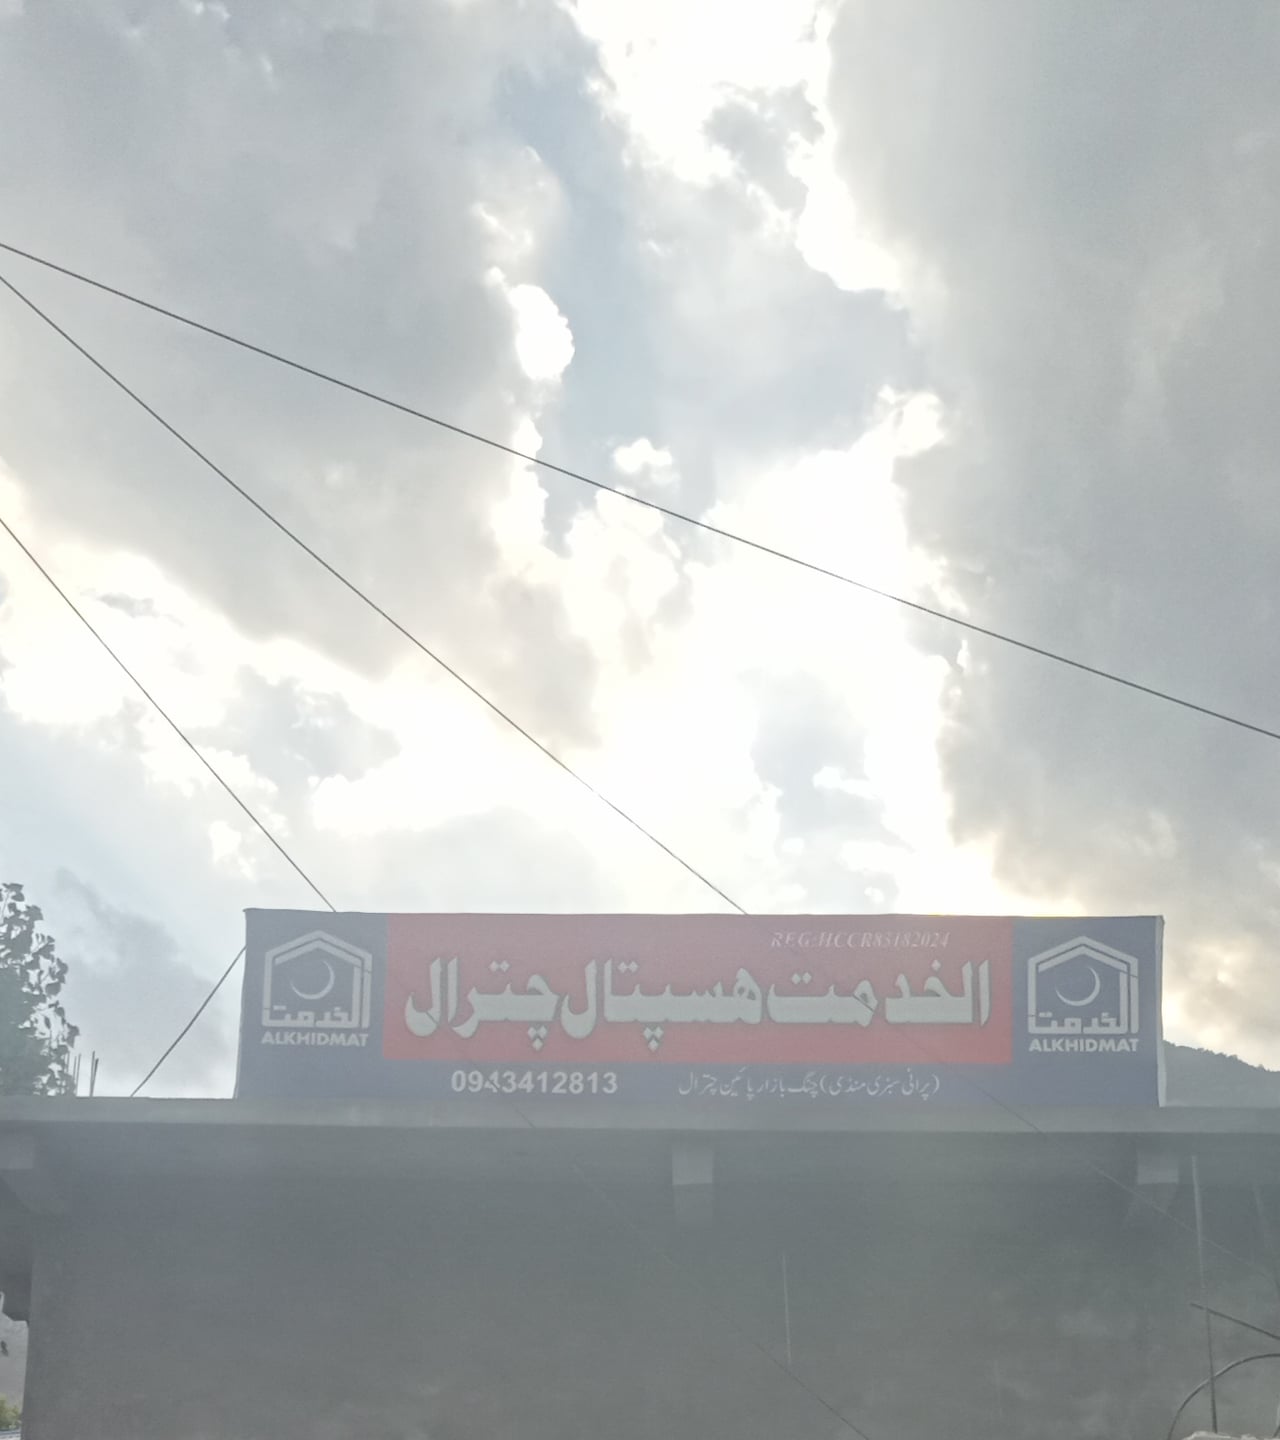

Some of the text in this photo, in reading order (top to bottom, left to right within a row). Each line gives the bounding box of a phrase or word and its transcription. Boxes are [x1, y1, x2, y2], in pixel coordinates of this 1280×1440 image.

[403, 956, 992, 1051] الخدمت هسپتال چترال
[260, 1031, 369, 1047] ALKHIDMAT
[1027, 1038, 1139, 1053] ALKHIDMAT
[450, 1069, 618, 1094] 0943412813
